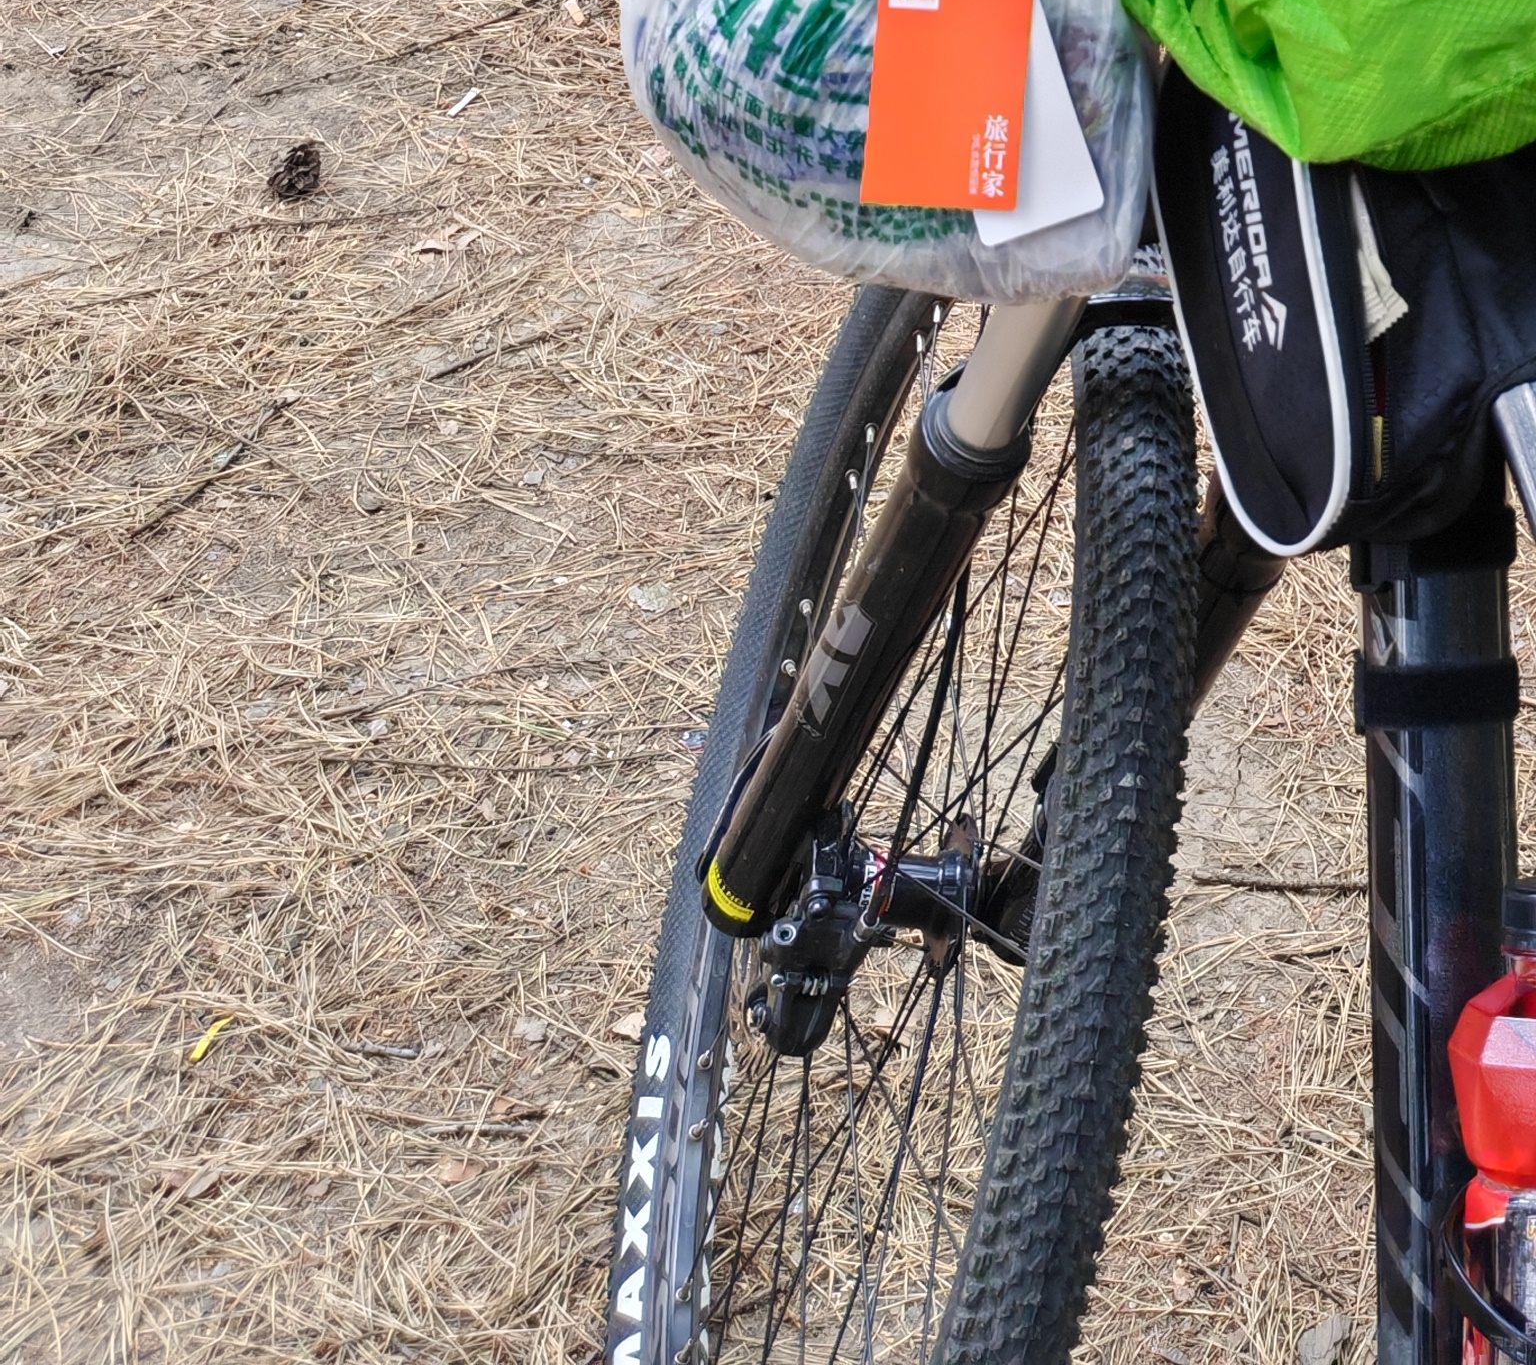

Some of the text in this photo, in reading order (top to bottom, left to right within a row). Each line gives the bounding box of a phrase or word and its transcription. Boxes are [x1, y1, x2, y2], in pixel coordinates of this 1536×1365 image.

[981, 114, 1009, 199] 旅行家
[1210, 145, 1262, 353] 美利达自行车
